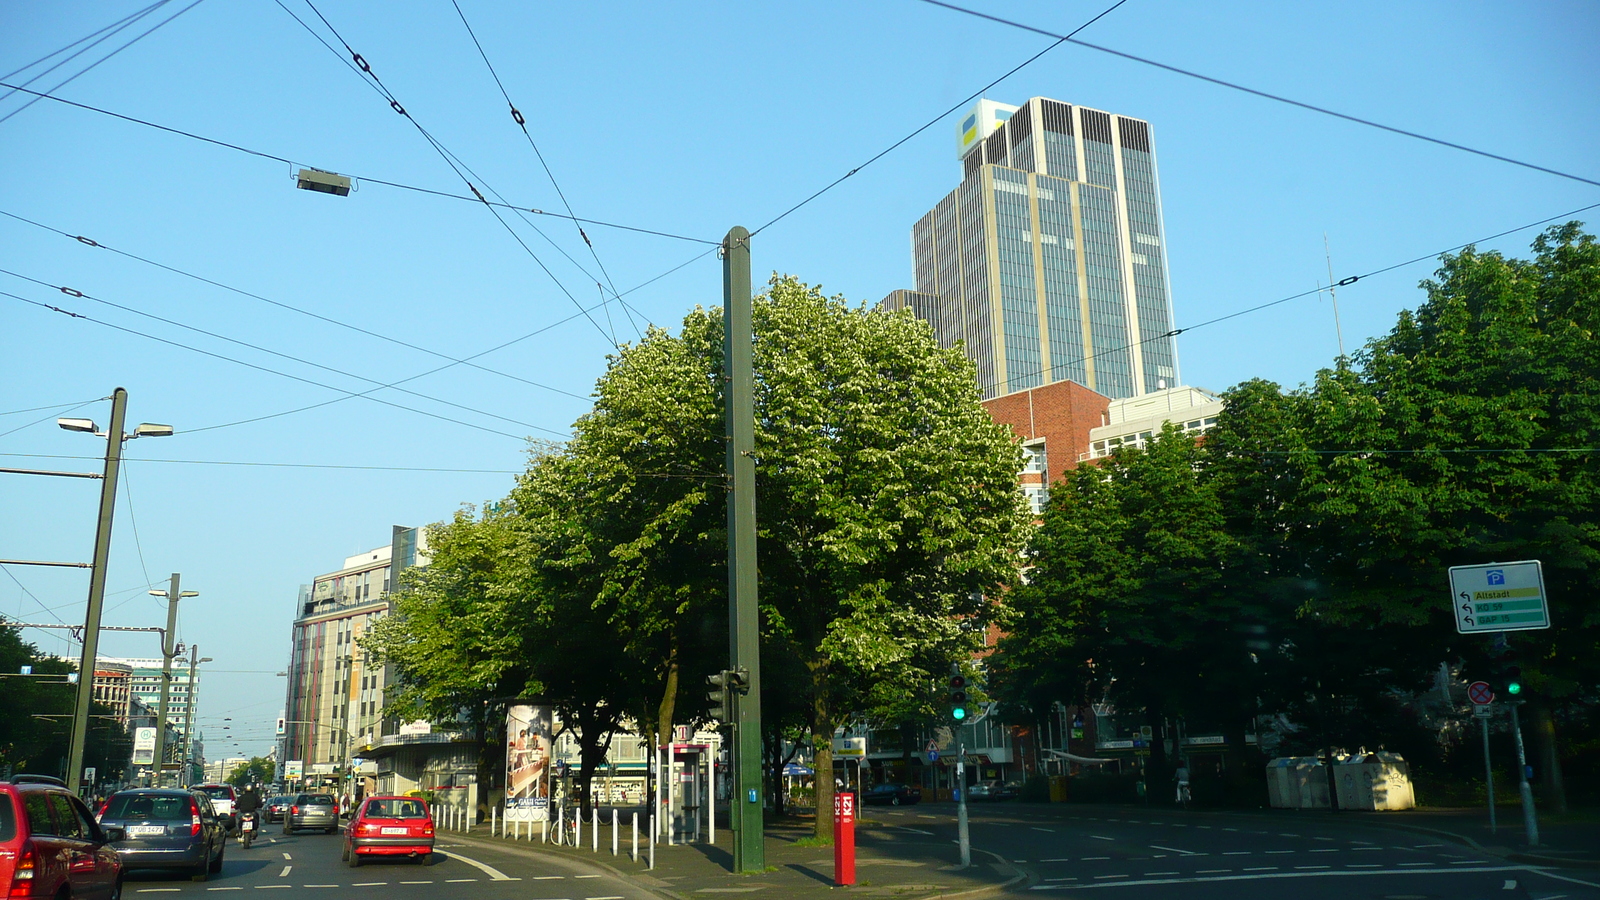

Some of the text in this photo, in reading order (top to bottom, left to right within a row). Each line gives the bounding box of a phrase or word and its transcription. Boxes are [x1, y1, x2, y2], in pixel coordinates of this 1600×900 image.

[1476, 590, 1510, 600] Altstadt
[1492, 603, 1503, 611] 59
[1479, 614, 1510, 624] GAP 15
[678, 726, 688, 740] T
[843, 796, 852, 816] K21
